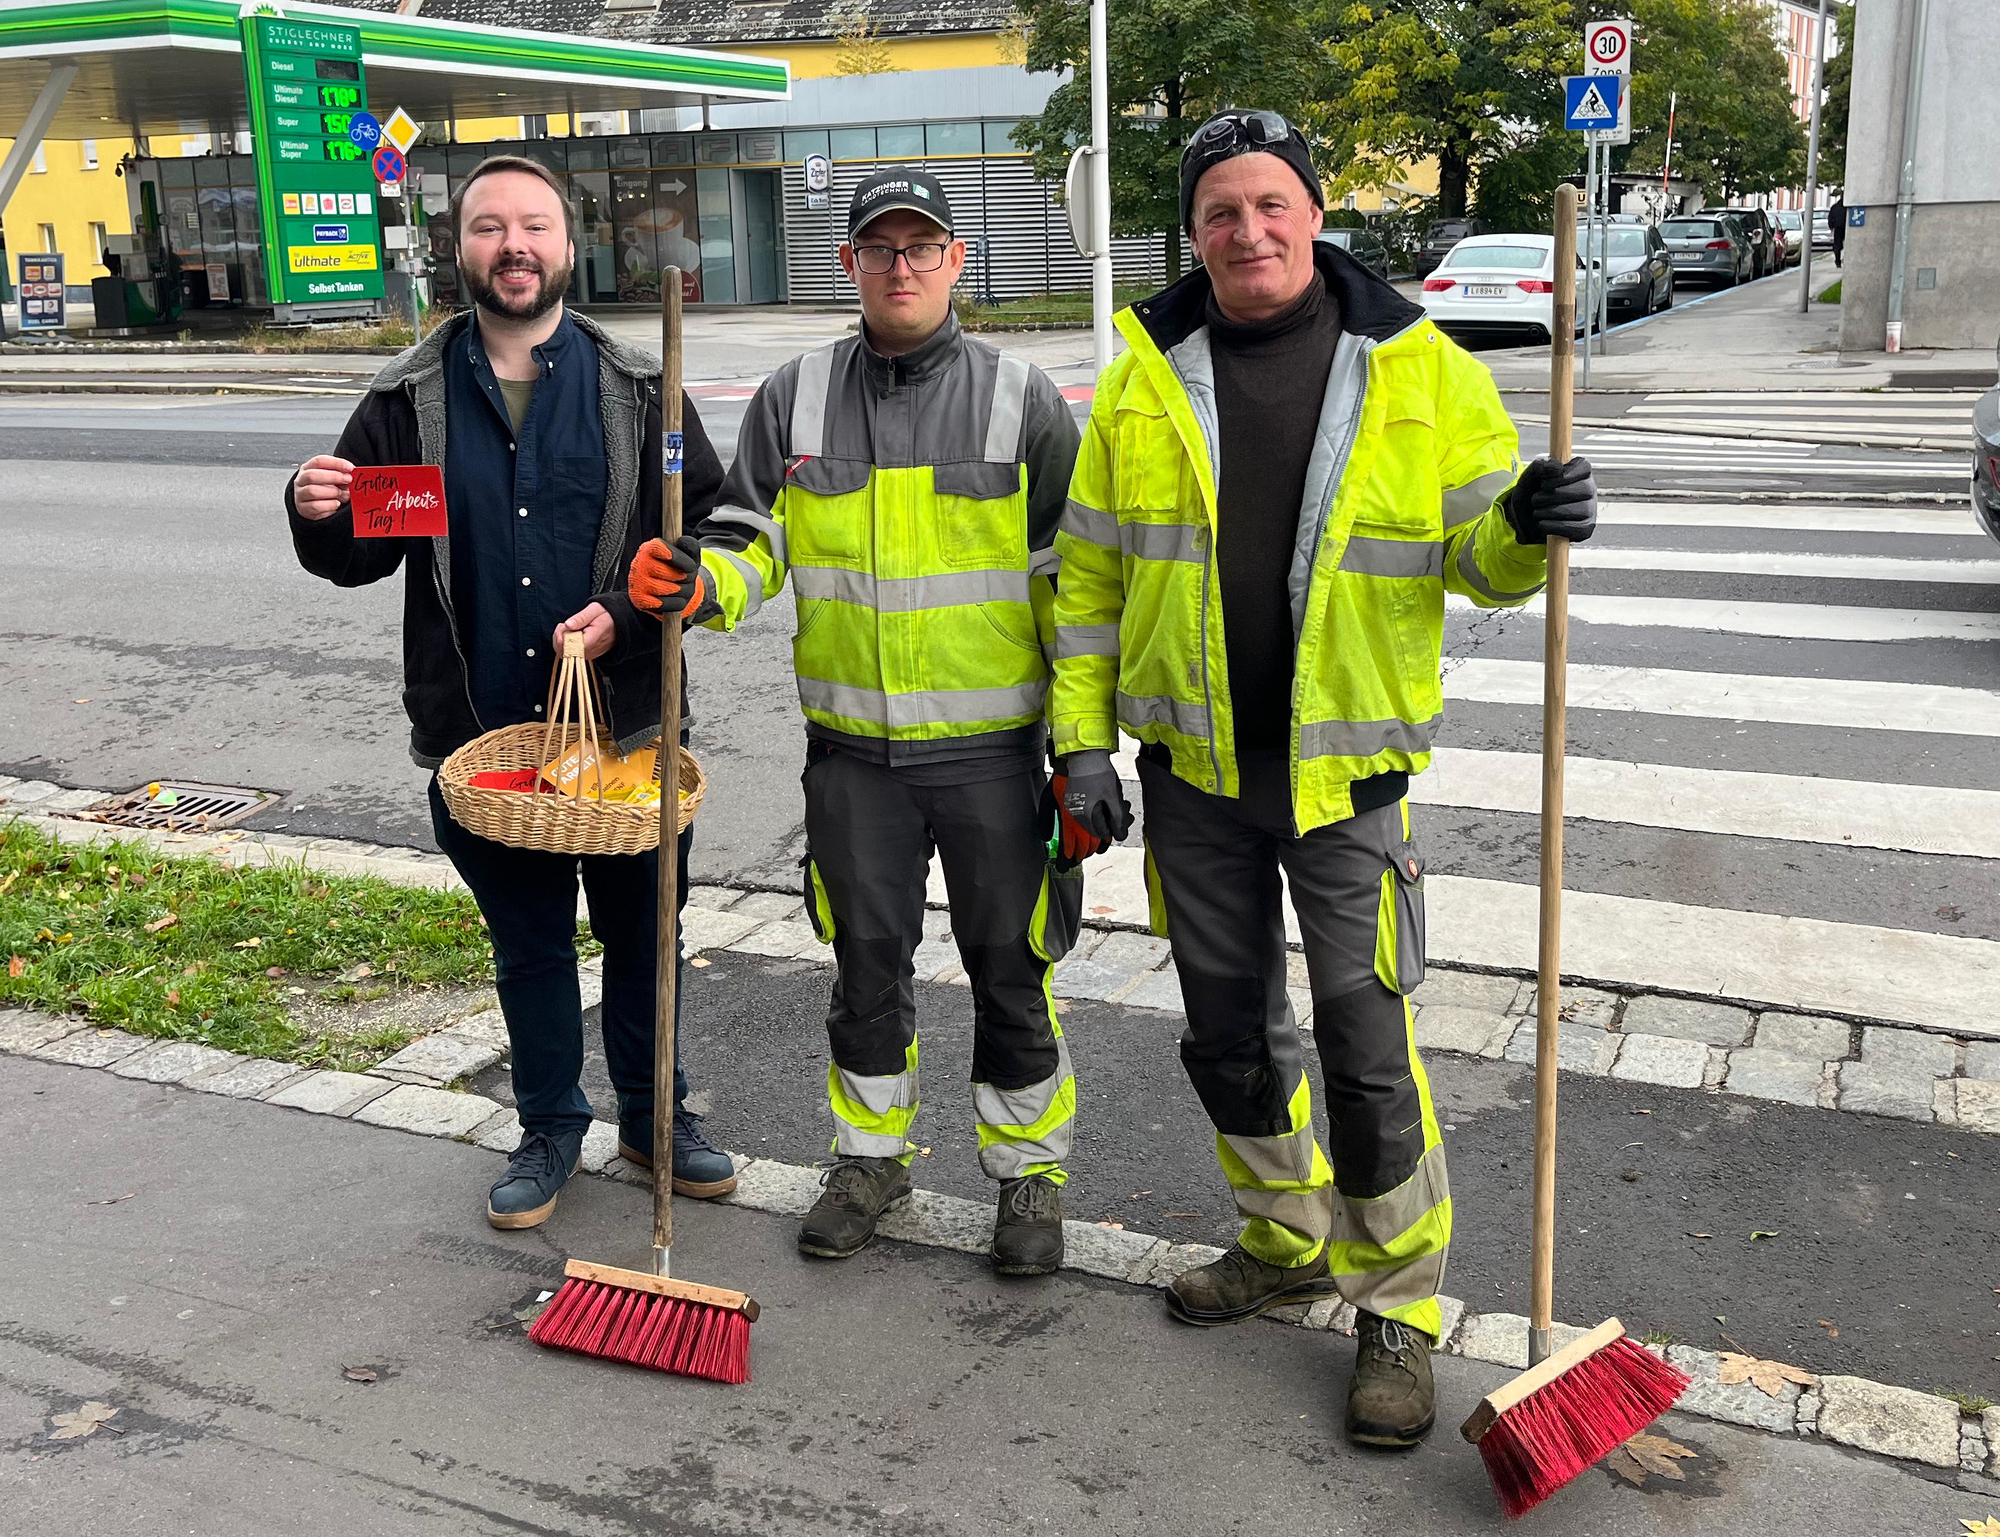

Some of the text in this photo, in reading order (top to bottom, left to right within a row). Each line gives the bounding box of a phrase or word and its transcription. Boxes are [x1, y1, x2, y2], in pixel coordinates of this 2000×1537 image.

[268, 26, 352, 43] STIGLECHNER
[1599, 36, 1617, 54] 30
[271, 61, 294, 71] Diesel
[273, 85, 303, 95] Ultimate
[275, 94, 298, 103] Diesel
[277, 117, 299, 127] Super
[280, 141, 309, 150] Ultimate
[280, 150, 302, 159] Super
[616, 179, 648, 189] Eingang
[861, 188, 909, 206] LANDTECHNIK
[862, 181, 909, 201] KATZINGER
[294, 255, 341, 267] ultimate
[308, 282, 364, 294] Selbst Tanken
[354, 472, 399, 496] Guten
[386, 490, 440, 511] Arbeits
